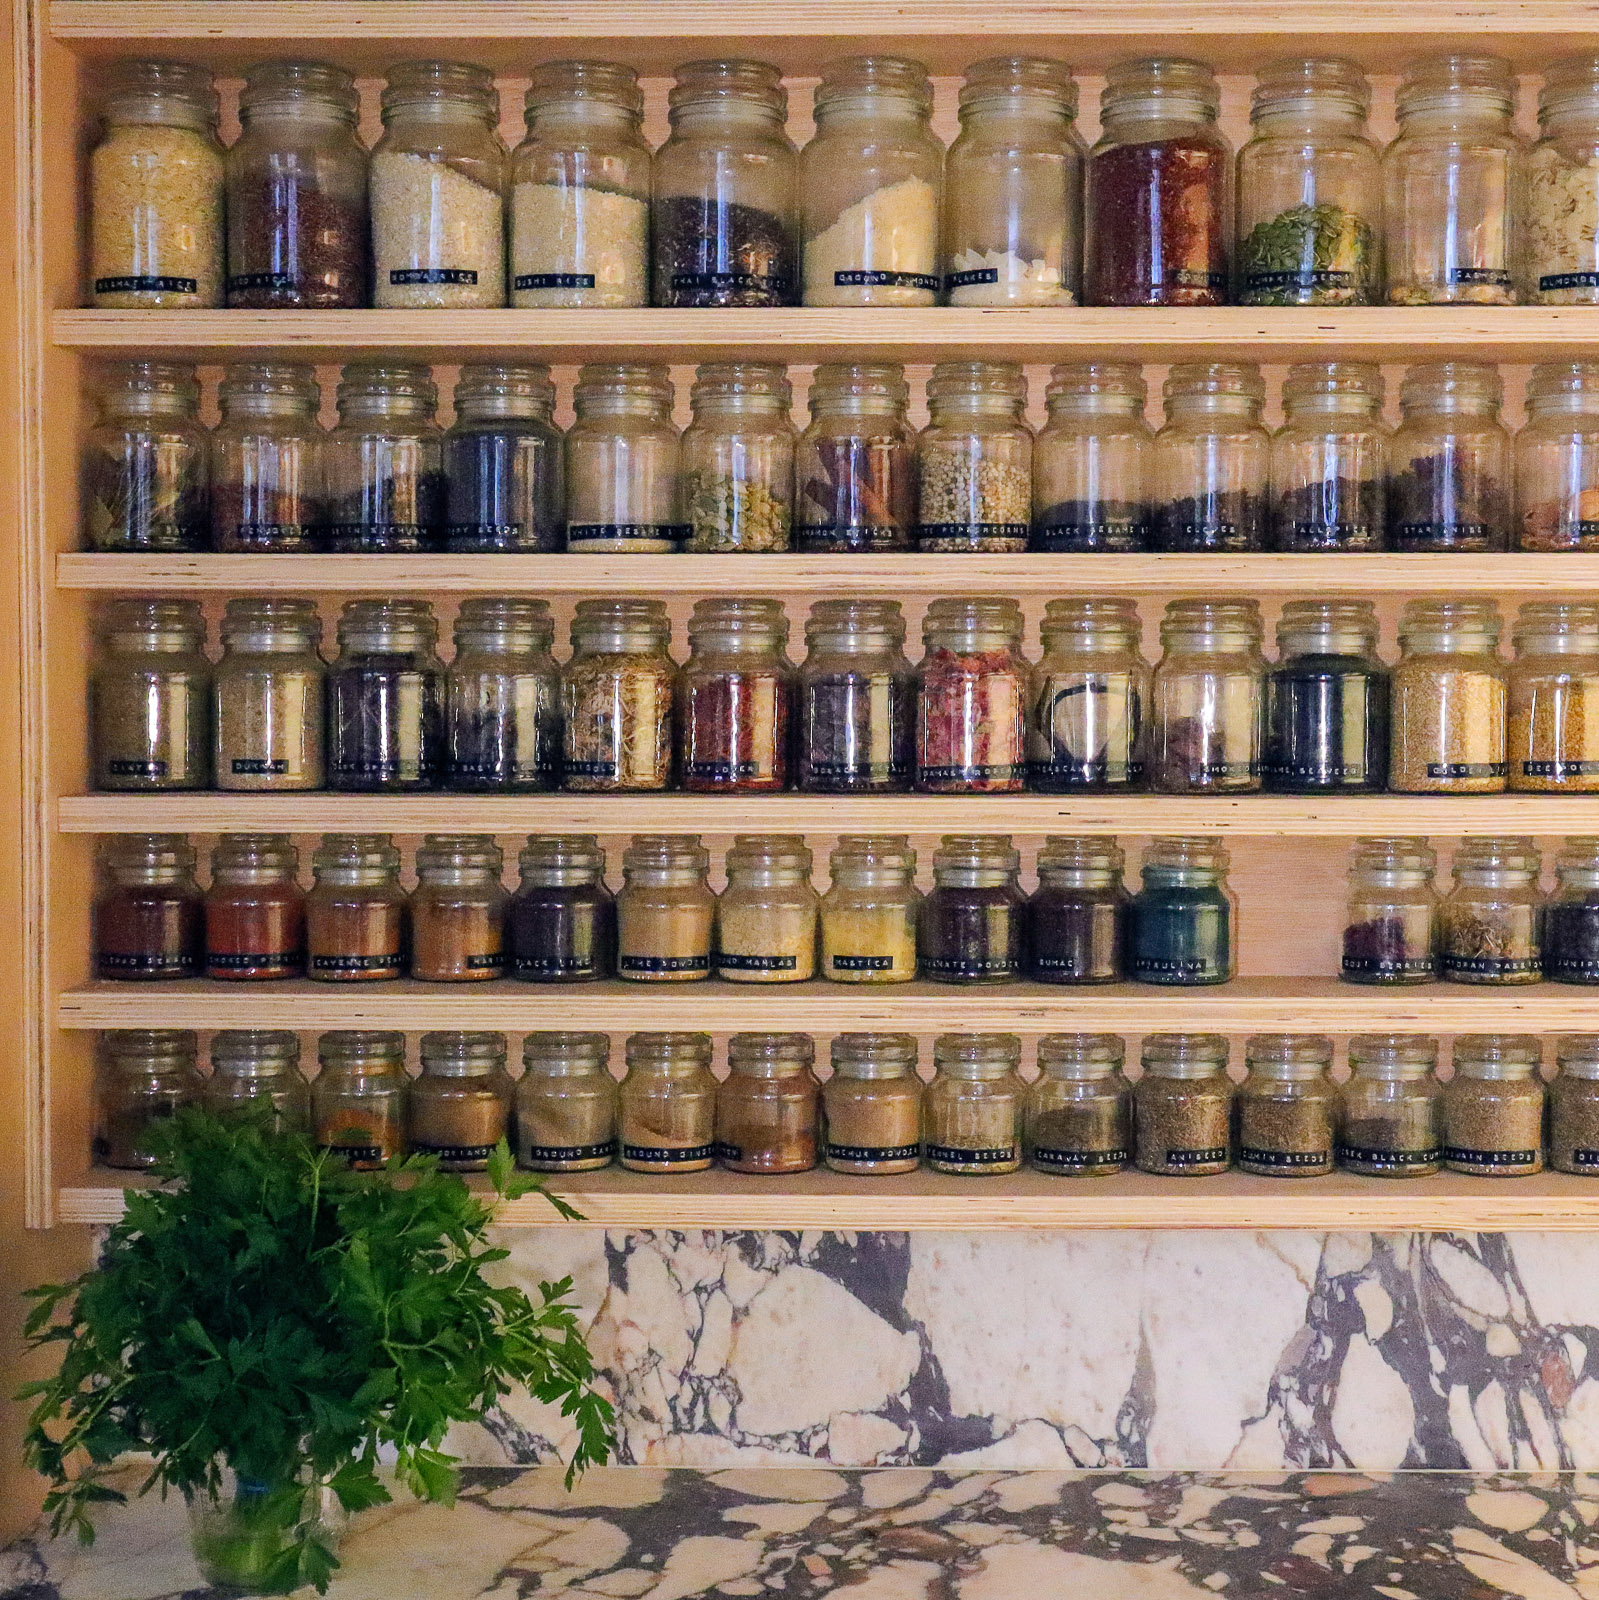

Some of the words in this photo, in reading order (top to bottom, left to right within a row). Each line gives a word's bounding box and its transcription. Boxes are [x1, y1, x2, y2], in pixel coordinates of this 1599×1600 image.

[556, 277, 589, 287] RICE
[673, 276, 700, 285] THAI
[838, 273, 887, 283] GROUND
[1404, 526, 1432, 535] STAR
[1527, 764, 1551, 774] BEE
[315, 958, 371, 967] CAYENNE
[834, 958, 889, 968] MASTICA
[1039, 958, 1074, 968] SUMAC
[535, 1148, 583, 1159] GROUND
[625, 1149, 670, 1160] GROUND
[974, 1151, 1012, 1161] SEEDS
[1037, 1150, 1088, 1163] CARAWAY
[1170, 1150, 1223, 1162] ANISEED
[1371, 1152, 1414, 1163] BLACK
[1493, 1153, 1531, 1162] SEEDS
[1285, 1154, 1324, 1164] SEEDS
